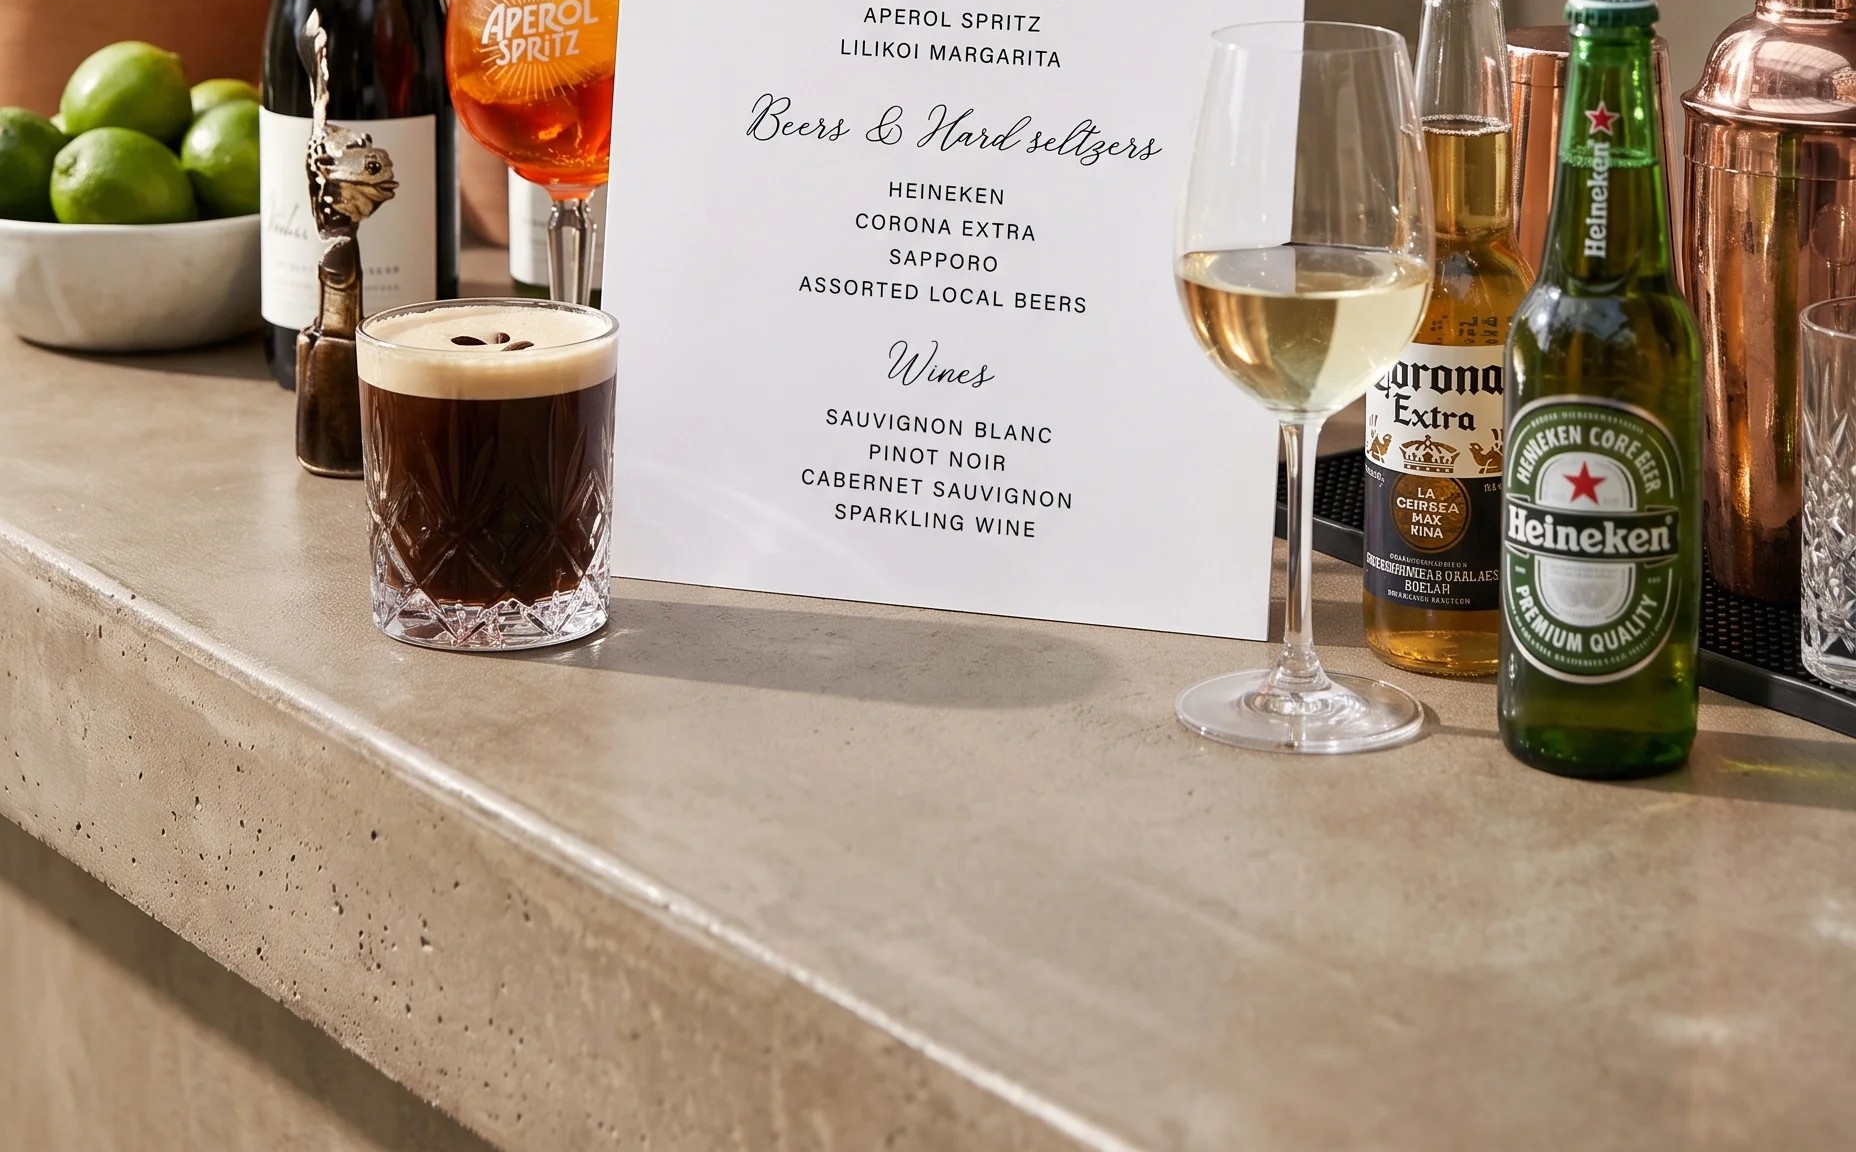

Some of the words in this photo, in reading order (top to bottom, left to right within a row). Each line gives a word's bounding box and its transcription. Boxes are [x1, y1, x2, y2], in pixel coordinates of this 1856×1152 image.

[863, 6, 952, 28] APEROL
[961, 12, 1041, 33] SPRITZ
[840, 38, 919, 60] LILIKOI
[929, 44, 1061, 69] MARGARITA
[745, 92, 851, 142] Beers
[865, 104, 904, 146] &
[916, 103, 1033, 152] Hard
[1025, 118, 1163, 167] seltzers
[888, 181, 1004, 206] HEINEKEN
[1583, 141, 1611, 259] Heineken
[855, 212, 952, 236] CORONA
[962, 219, 1036, 242] EXTRA
[889, 248, 998, 273] SAPPORO
[798, 275, 919, 301] ASSORTED
[929, 285, 1004, 308] LOCAL
[1014, 291, 1086, 314] BEERS
[887, 339, 996, 389] Wines
[825, 408, 963, 437] SAUVIGNON
[974, 421, 1052, 444] BLANC
[1393, 392, 1477, 432] Extra
[869, 443, 939, 466] PINOT
[949, 450, 1006, 472] NOIR
[801, 468, 924, 496] CABERNET
[932, 480, 1072, 510] SAUVIGNON
[1417, 487, 1436, 500] LA
[834, 503, 964, 532] SPARKLING
[975, 516, 1035, 538] WINE
[1507, 504, 1672, 555] Heineken
[1516, 585, 1583, 654] PREMIUM
[1589, 593, 1658, 654] QUALITY
